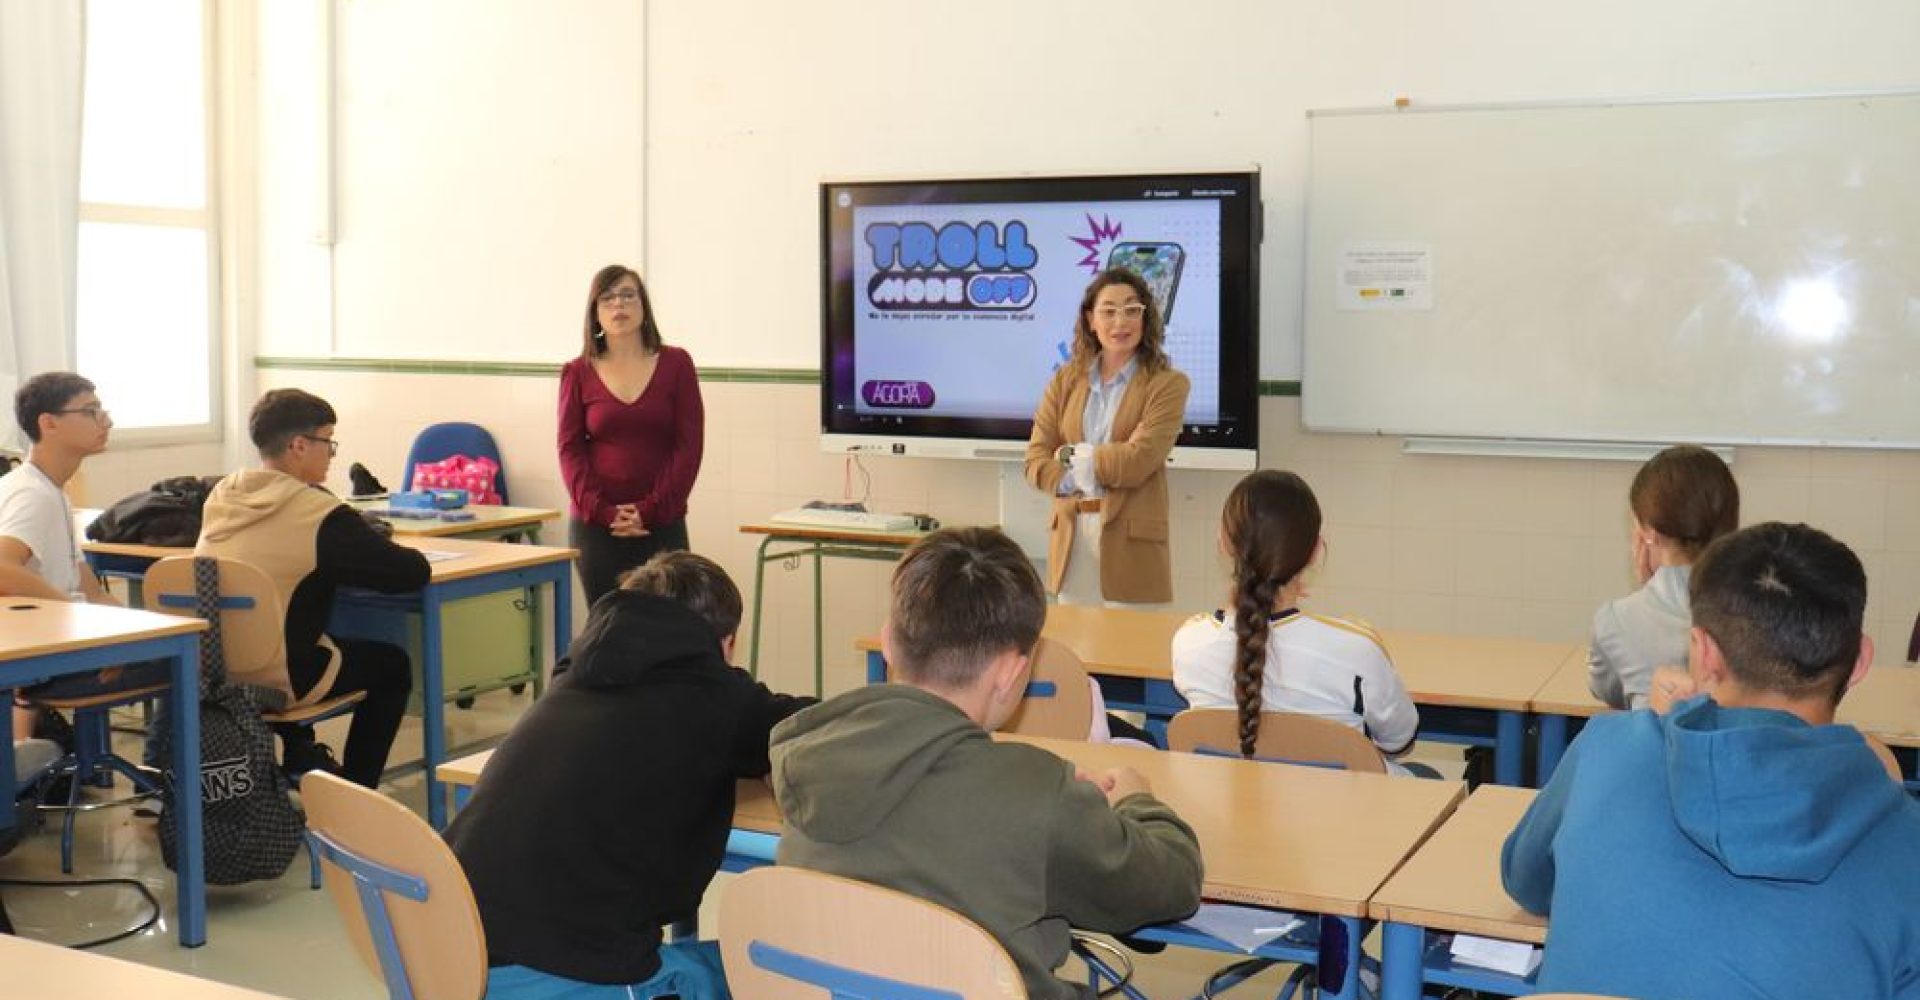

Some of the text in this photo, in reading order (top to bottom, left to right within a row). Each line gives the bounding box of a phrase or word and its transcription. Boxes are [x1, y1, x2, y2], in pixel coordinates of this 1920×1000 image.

[864, 220, 1038, 271] TROLL
[872, 276, 1032, 304] MODE OFF
